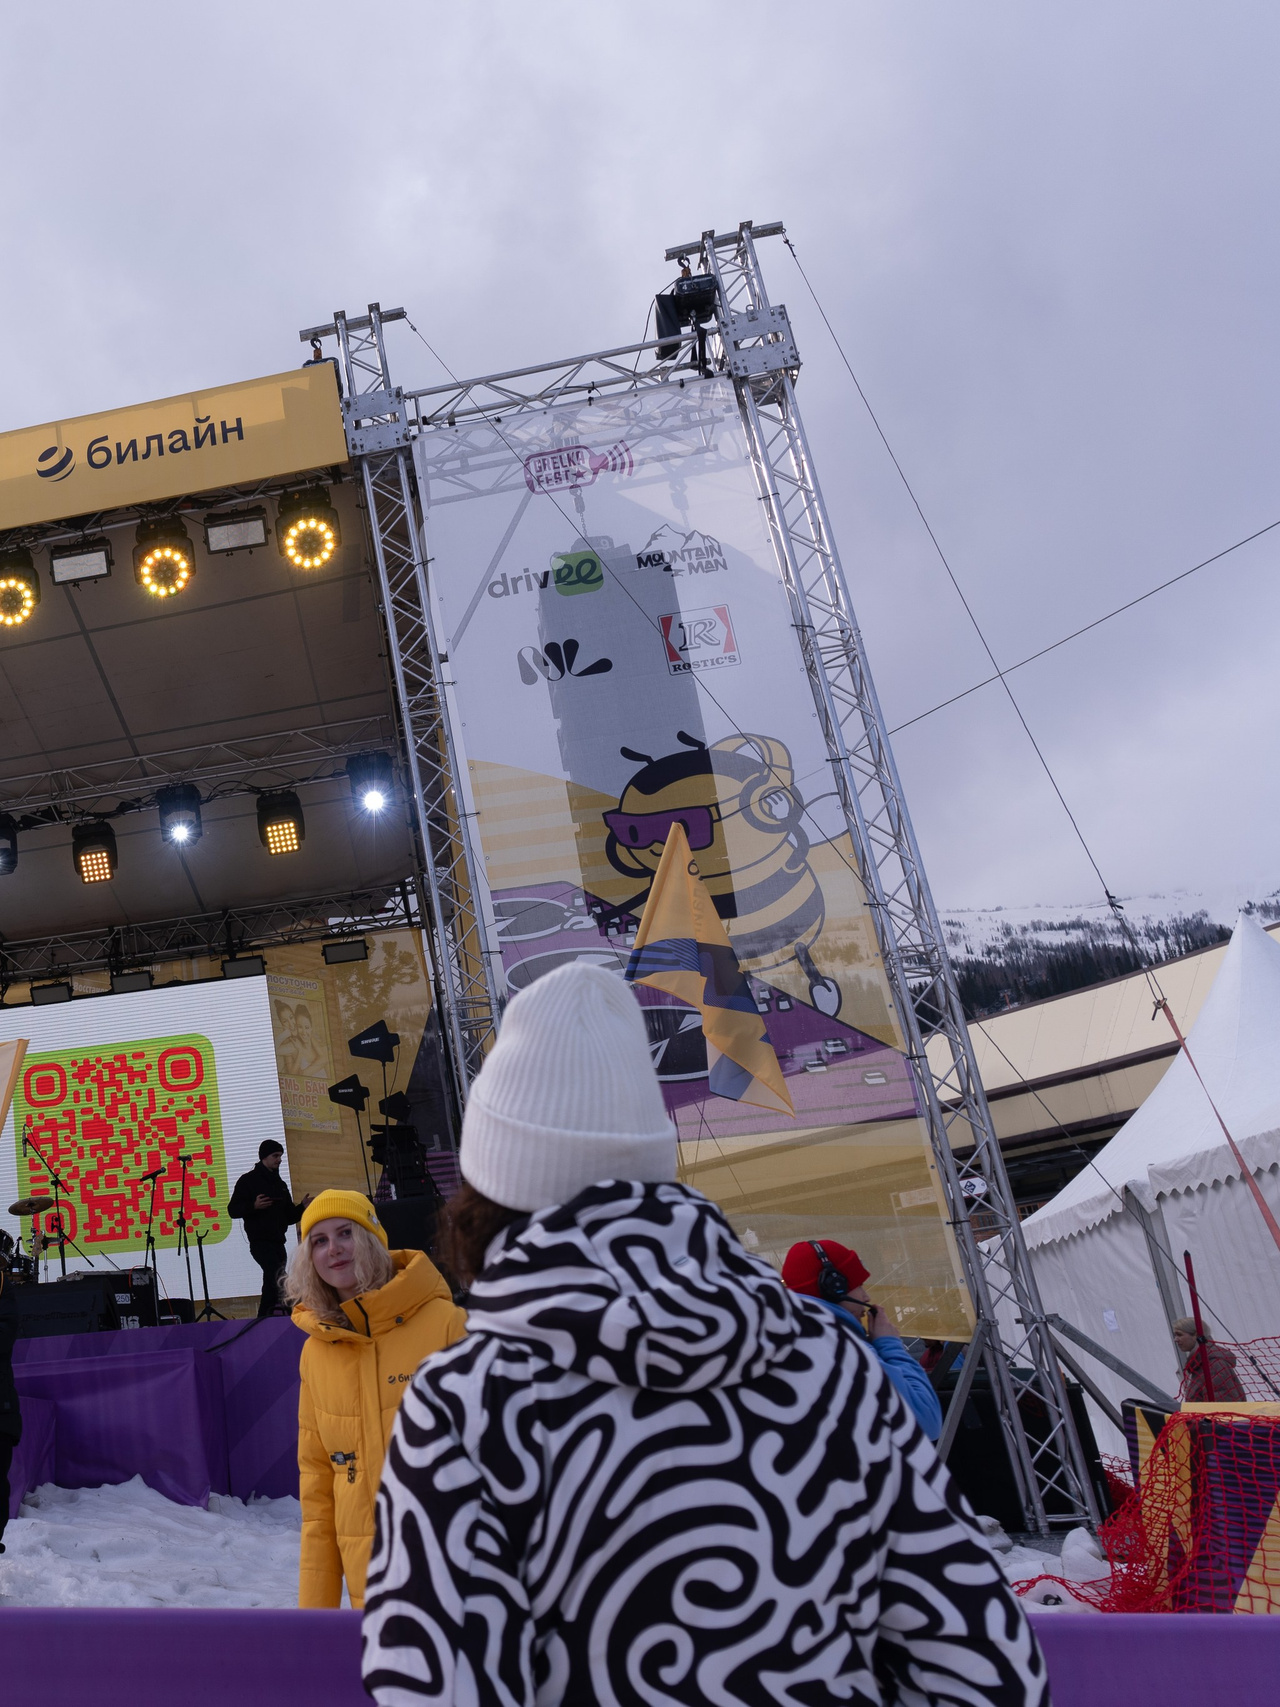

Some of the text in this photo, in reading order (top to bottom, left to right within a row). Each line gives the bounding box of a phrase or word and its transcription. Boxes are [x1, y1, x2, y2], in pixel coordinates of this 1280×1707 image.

[86, 415, 245, 471] билайн
[533, 450, 586, 473] GRELKA
[536, 469, 571, 488] FEST
[637, 544, 723, 569] MOUNTAIN
[687, 558, 728, 575] MAN
[487, 556, 604, 599] drivee
[671, 654, 738, 673] ROSTIC'S
[267, 974, 318, 990] ПОСУТОЧНО
[279, 1077, 300, 1091] ЕМЬ
[292, 1094, 319, 1108] ГОРЕ
